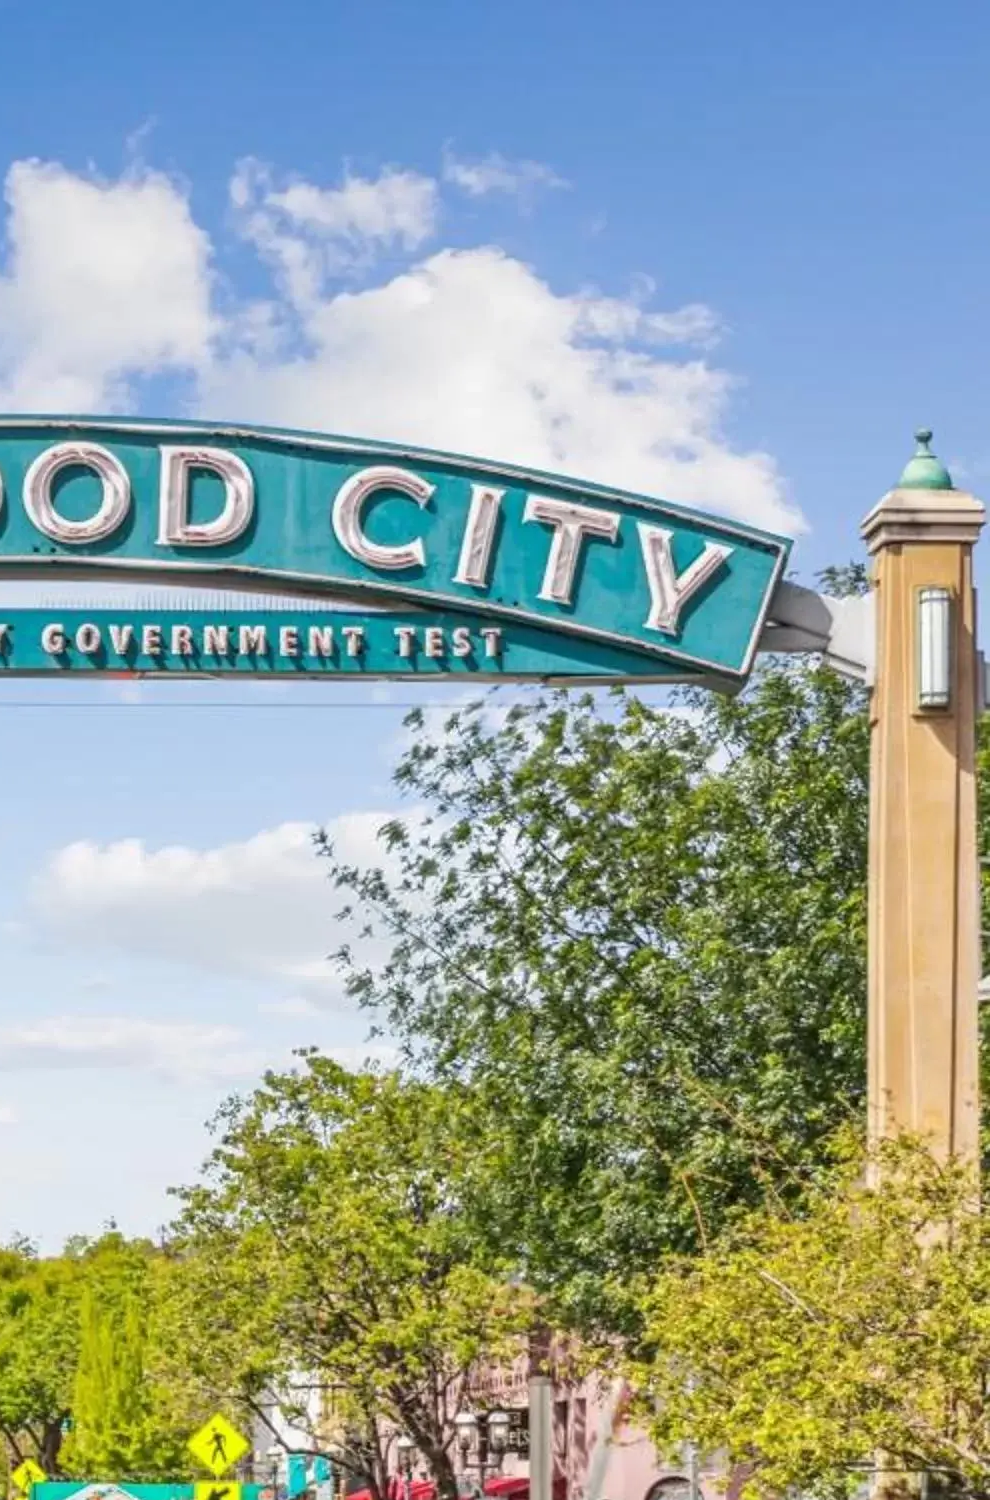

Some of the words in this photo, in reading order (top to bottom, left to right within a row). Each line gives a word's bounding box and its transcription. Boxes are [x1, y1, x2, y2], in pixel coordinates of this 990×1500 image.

[331, 466, 734, 637] CITY
[41, 623, 364, 656] GOVERNMENT
[394, 626, 501, 658] TEST
